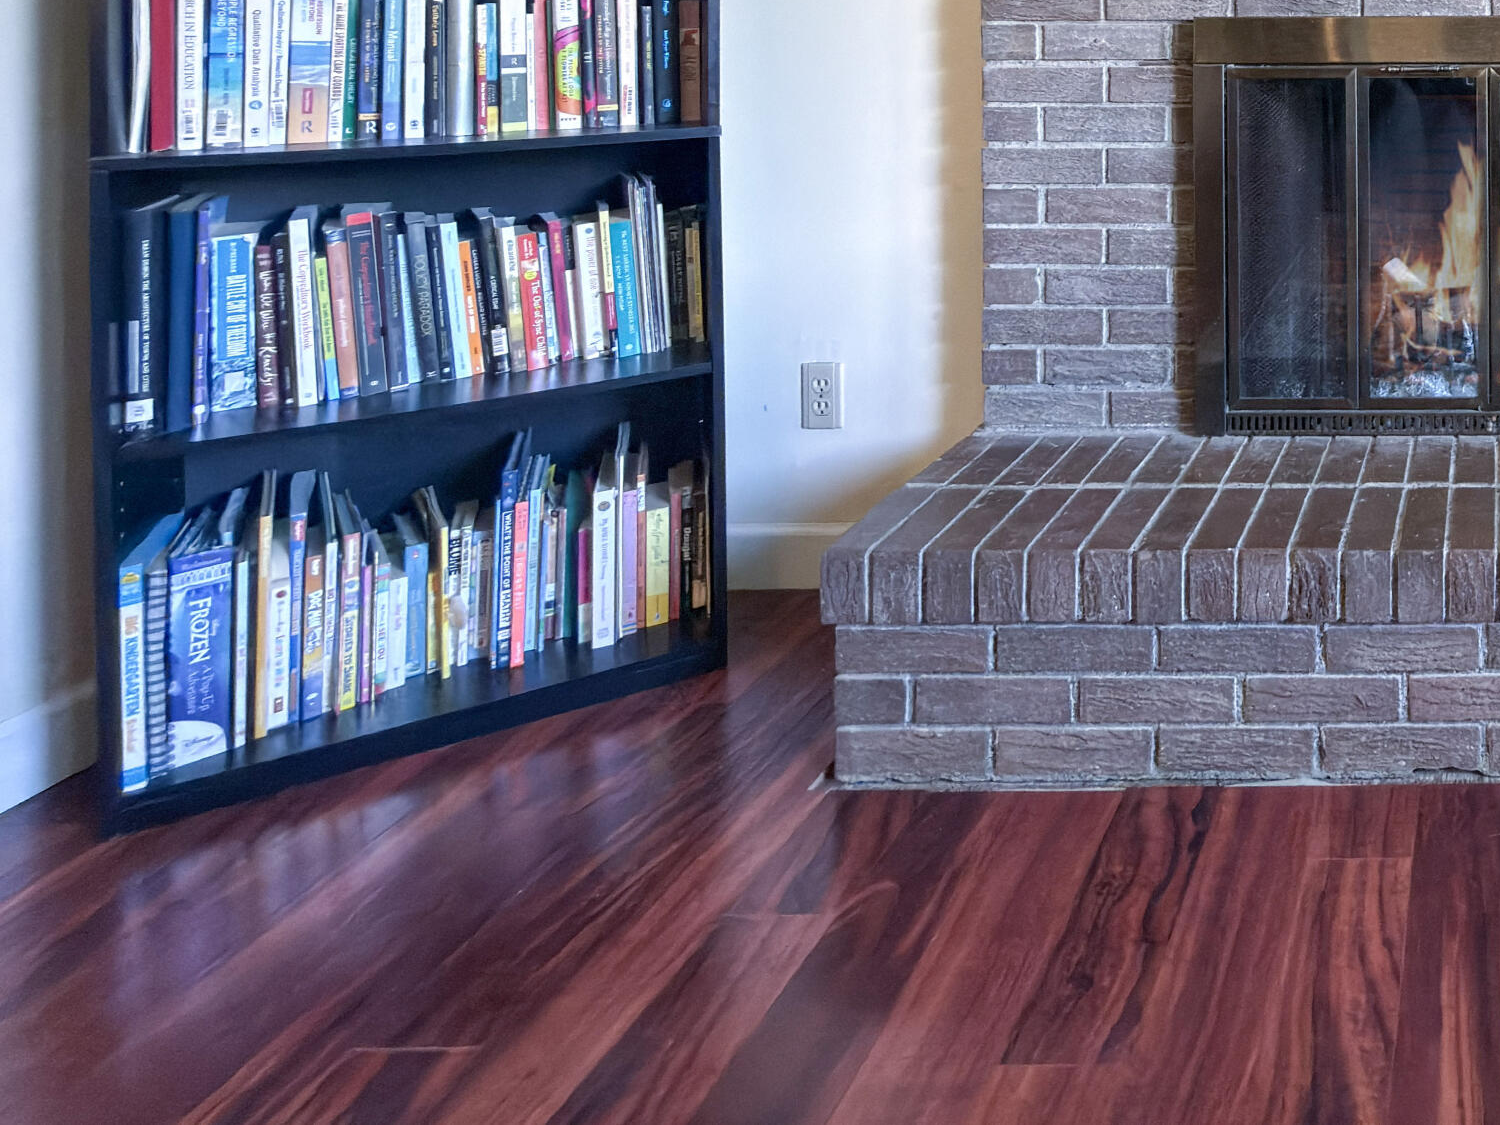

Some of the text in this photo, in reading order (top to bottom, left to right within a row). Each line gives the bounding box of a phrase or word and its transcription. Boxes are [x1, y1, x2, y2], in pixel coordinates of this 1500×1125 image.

[277, 1, 286, 29] Qualitative
[315, 0, 323, 35] REGRESSION
[336, 3, 344, 13] THE
[185, 22, 195, 31] IN
[227, 17, 237, 63] REGRESSION
[275, 30, 285, 48] Inquiry
[184, 35, 197, 89] EDUCATION
[250, 9, 262, 97] Qualitative Data Analysis
[334, 32, 344, 58] SPORTING
[386, 31, 398, 61] Manual
[334, 60, 344, 74] CAMP
[360, 241, 369, 255] The
[585, 249, 596, 267] power
[260, 293, 274, 308] We
[296, 250, 313, 350] The Copyeditor's Workbook
[414, 255, 432, 337] POLICY PARADOX
[226, 275, 247, 357] BATTLE CRY OF FREEDOM
[532, 280, 546, 355] The Child
[504, 513, 512, 540] WHAT'S
[449, 538, 461, 576] BLUME
[503, 556, 511, 576] POINT
[503, 578, 510, 589] OF
[308, 589, 322, 627] DOG MAN
[187, 596, 212, 665] FROZEN
[344, 617, 354, 652] STORIES
[345, 654, 352, 664] TO
[125, 637, 140, 717] KINDERGARTEN
[187, 671, 198, 715] Adventure
[201, 675, 214, 711] Pop-Up
